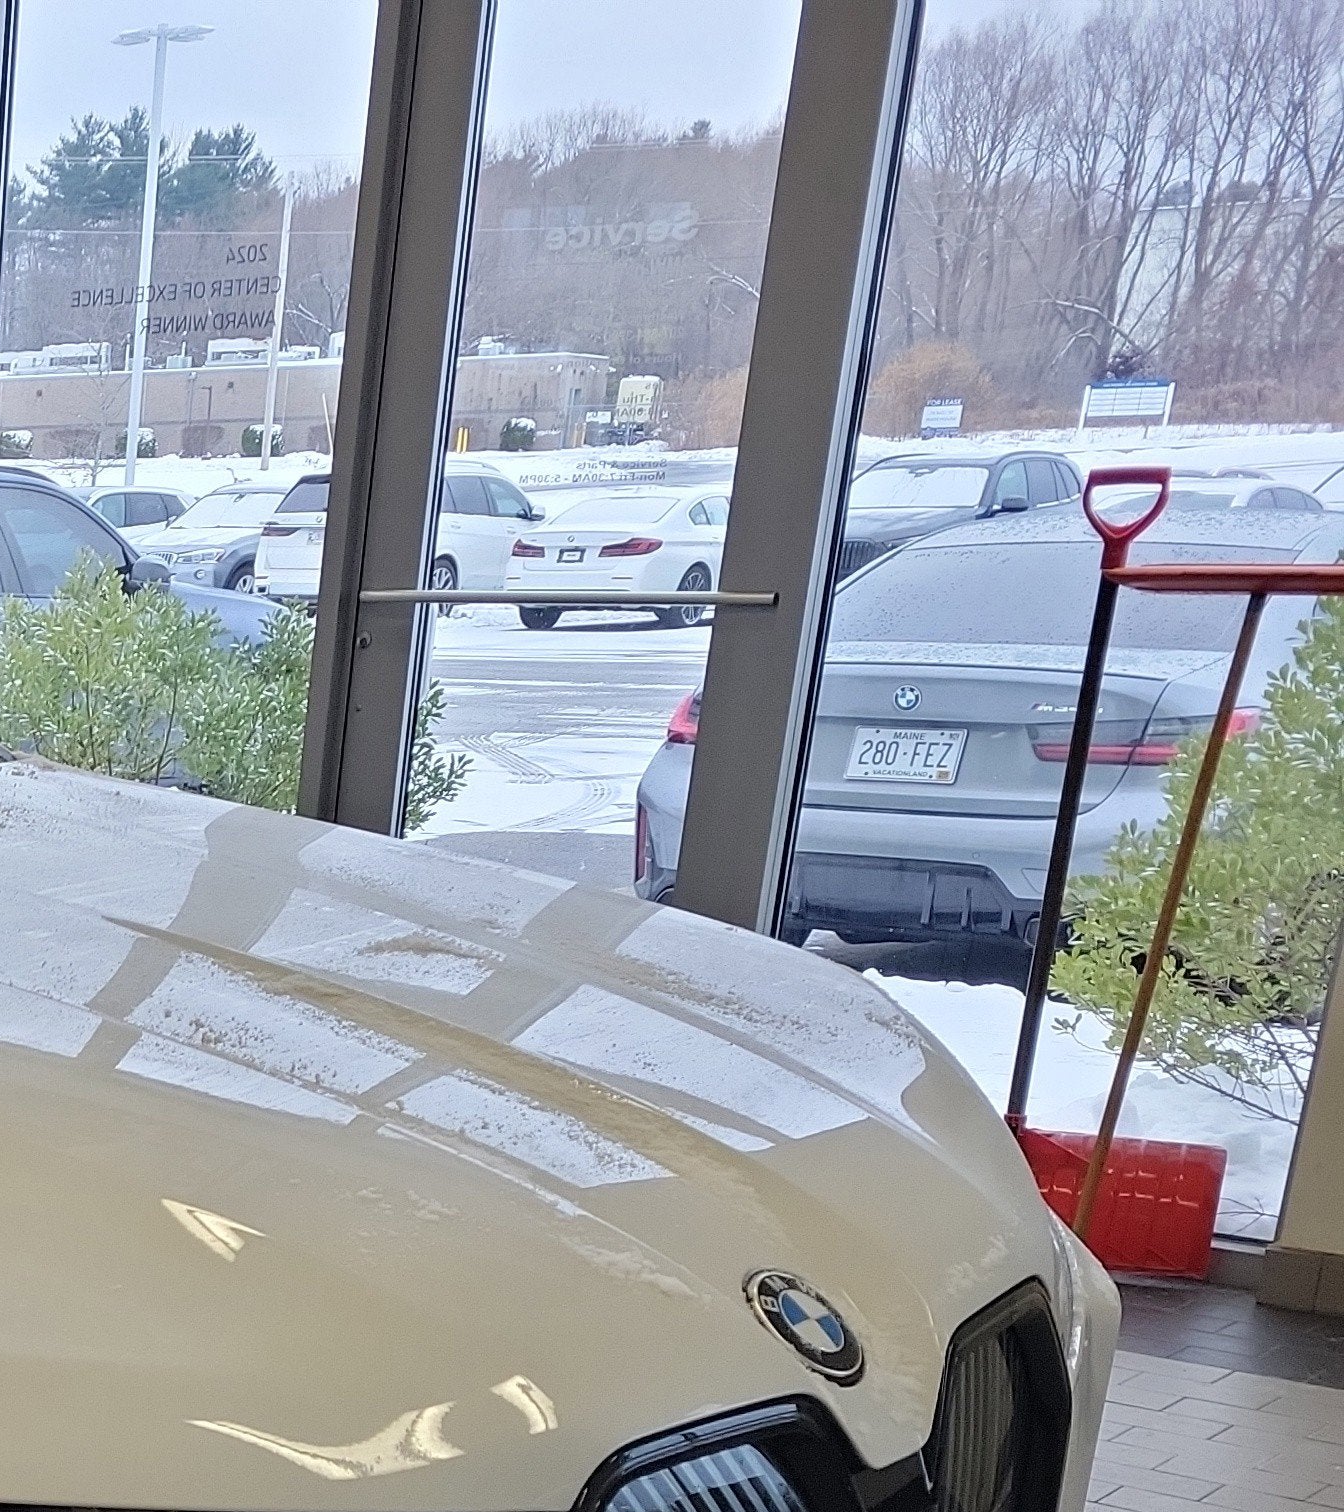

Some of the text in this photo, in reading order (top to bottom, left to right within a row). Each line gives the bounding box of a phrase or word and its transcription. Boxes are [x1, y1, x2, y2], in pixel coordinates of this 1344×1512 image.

[942, 398, 963, 406] LEASE
[893, 731, 927, 741] MAINE
[871, 769, 929, 778] VACATIONLAND
